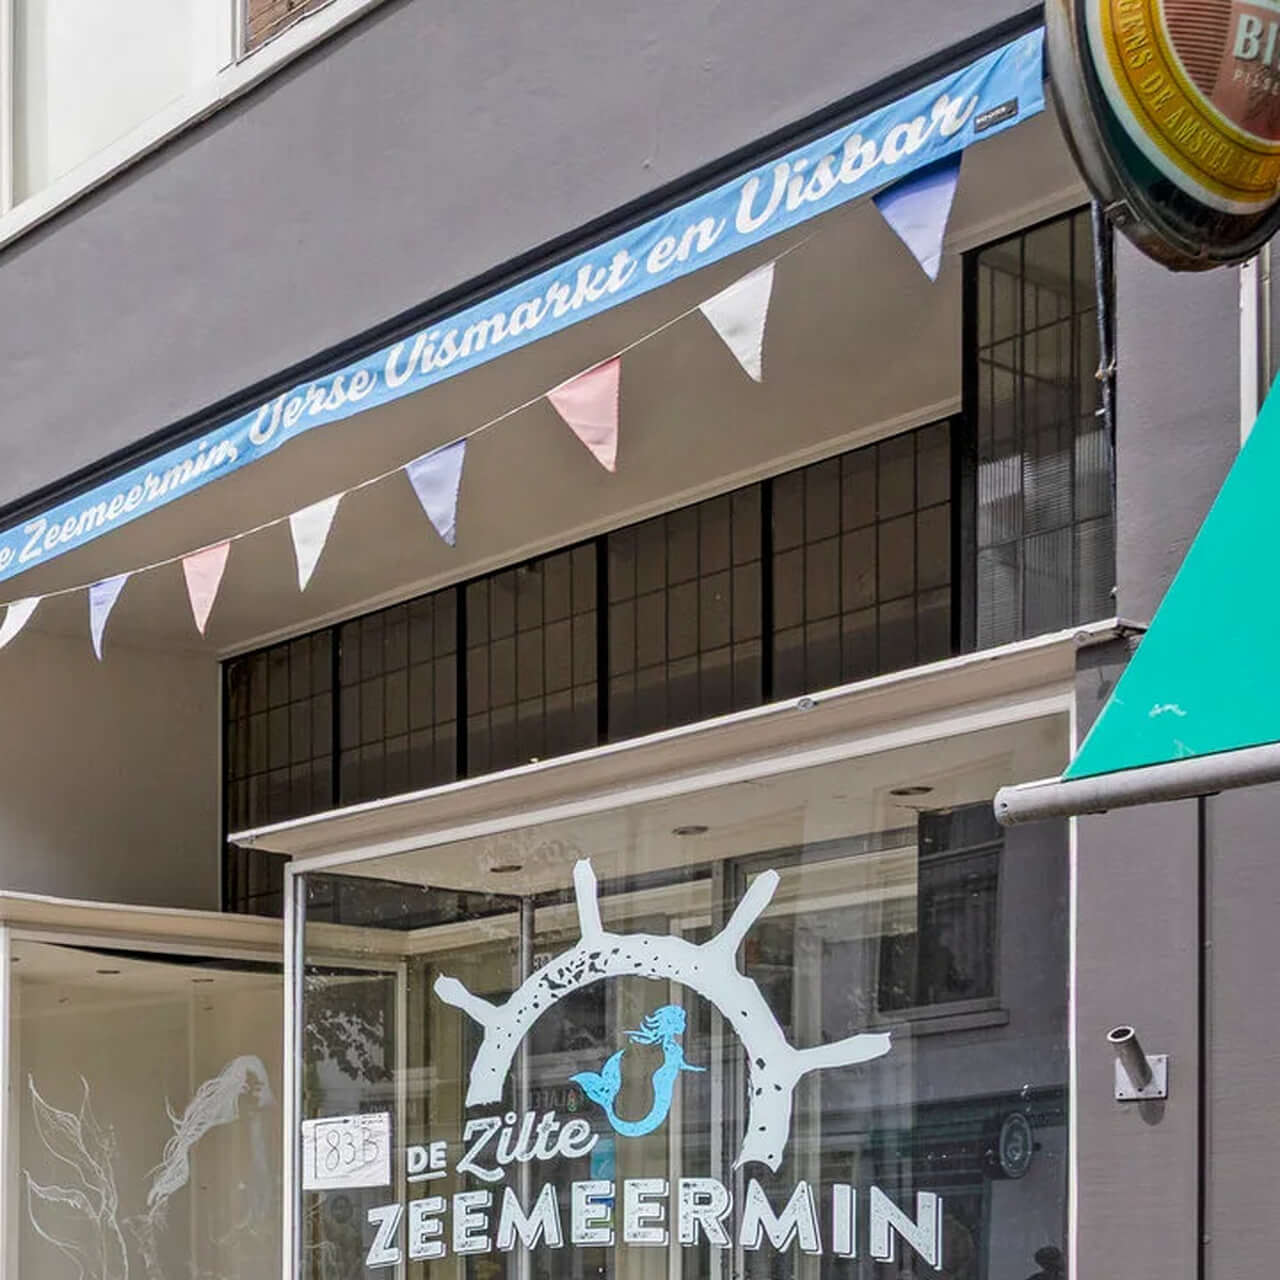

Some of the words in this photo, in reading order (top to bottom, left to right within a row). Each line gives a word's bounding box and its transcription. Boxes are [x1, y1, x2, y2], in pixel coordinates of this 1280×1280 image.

[1234, 14, 1280, 66] BI
[14, 432, 240, 561] Zeemeermin,
[249, 363, 377, 445] Verse
[385, 248, 640, 389] Vismarkt
[647, 209, 726, 275] en
[735, 94, 978, 234] Visbar
[407, 1142, 447, 1174] DE
[456, 1110, 599, 1182] Zilte
[365, 1178, 943, 1270] ZEEMEERMIN
